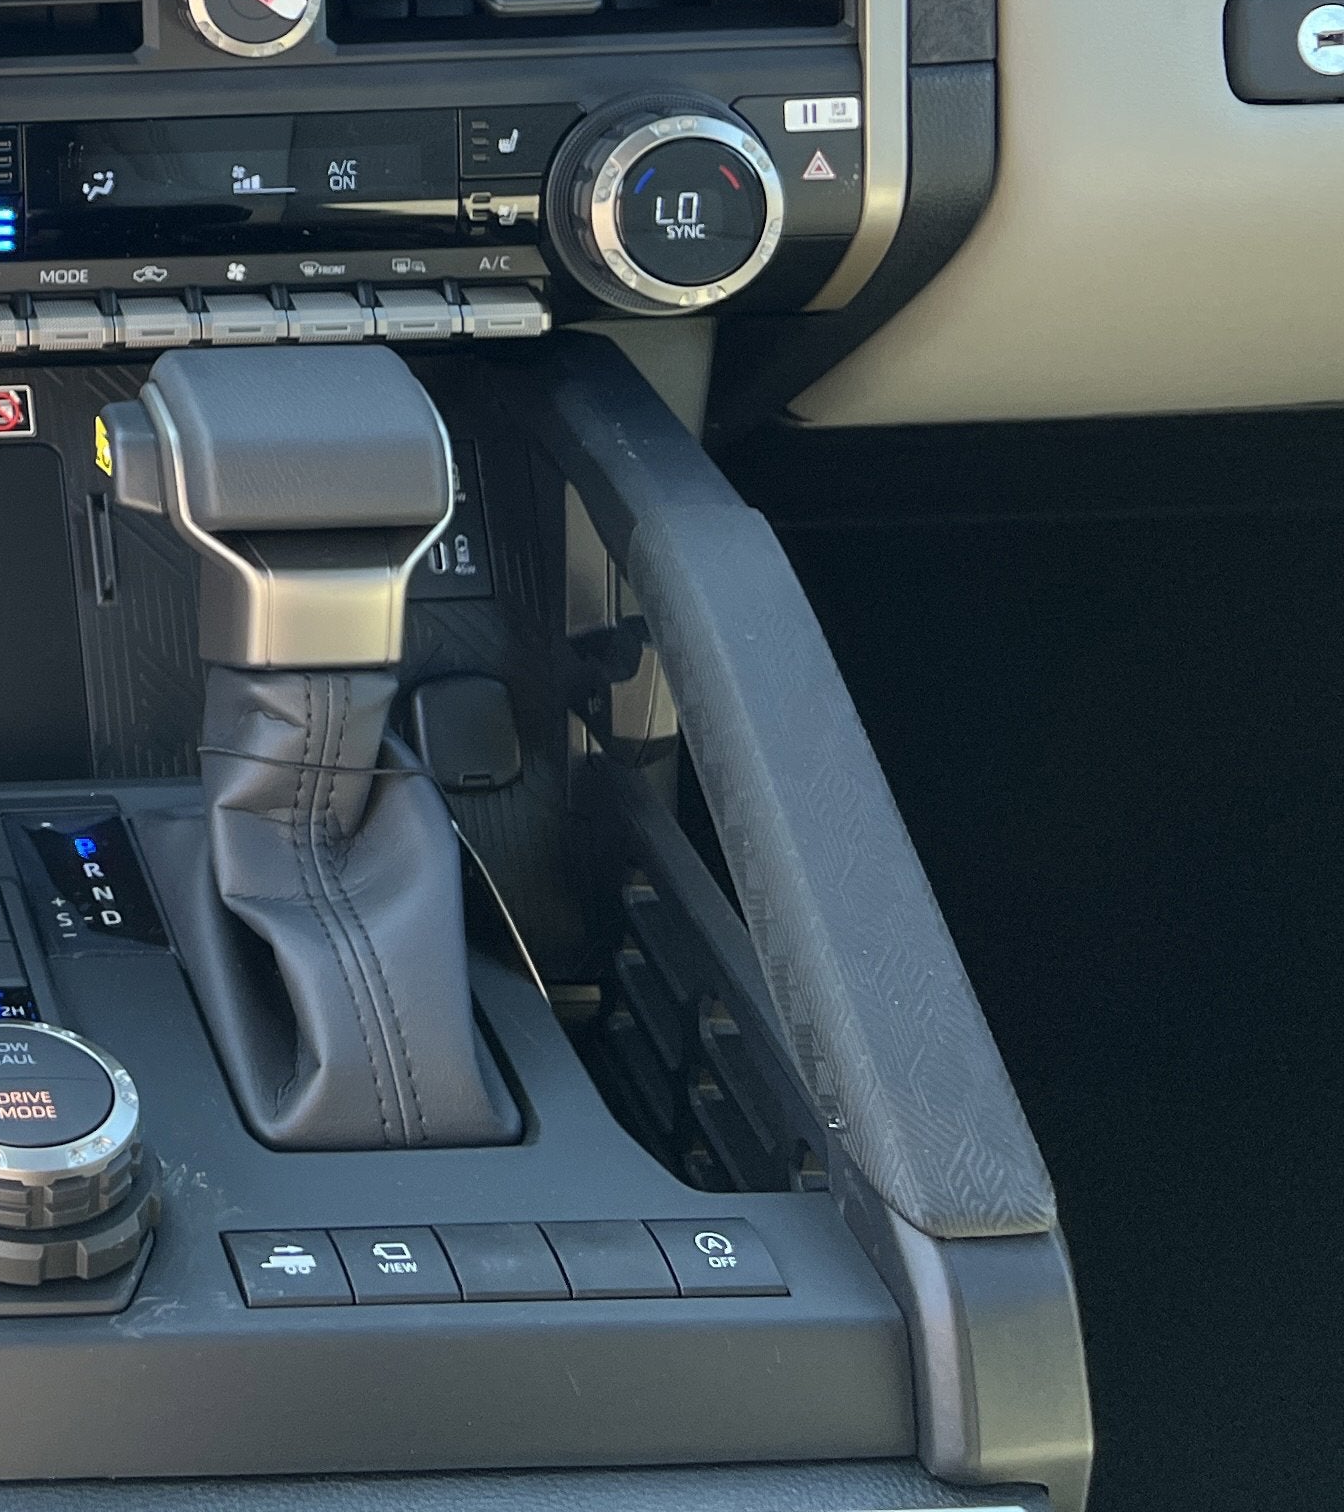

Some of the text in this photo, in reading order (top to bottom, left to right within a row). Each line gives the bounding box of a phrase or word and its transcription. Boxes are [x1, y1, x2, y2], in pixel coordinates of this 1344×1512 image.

[327, 159, 358, 176] A/C
[328, 175, 357, 191] ON
[666, 224, 706, 241] SYNC
[318, 265, 346, 275] FRONT
[479, 255, 512, 273] A/C
[39, 267, 89, 285] MODE
[74, 838, 97, 860] P
[82, 862, 105, 878] R
[92, 886, 114, 901] N
[56, 912, 74, 927] S
[101, 910, 122, 925] D
[0, 1005, 26, 1017] 2H
[378, 1261, 418, 1275] VIEW
[708, 1256, 738, 1269] OFF
